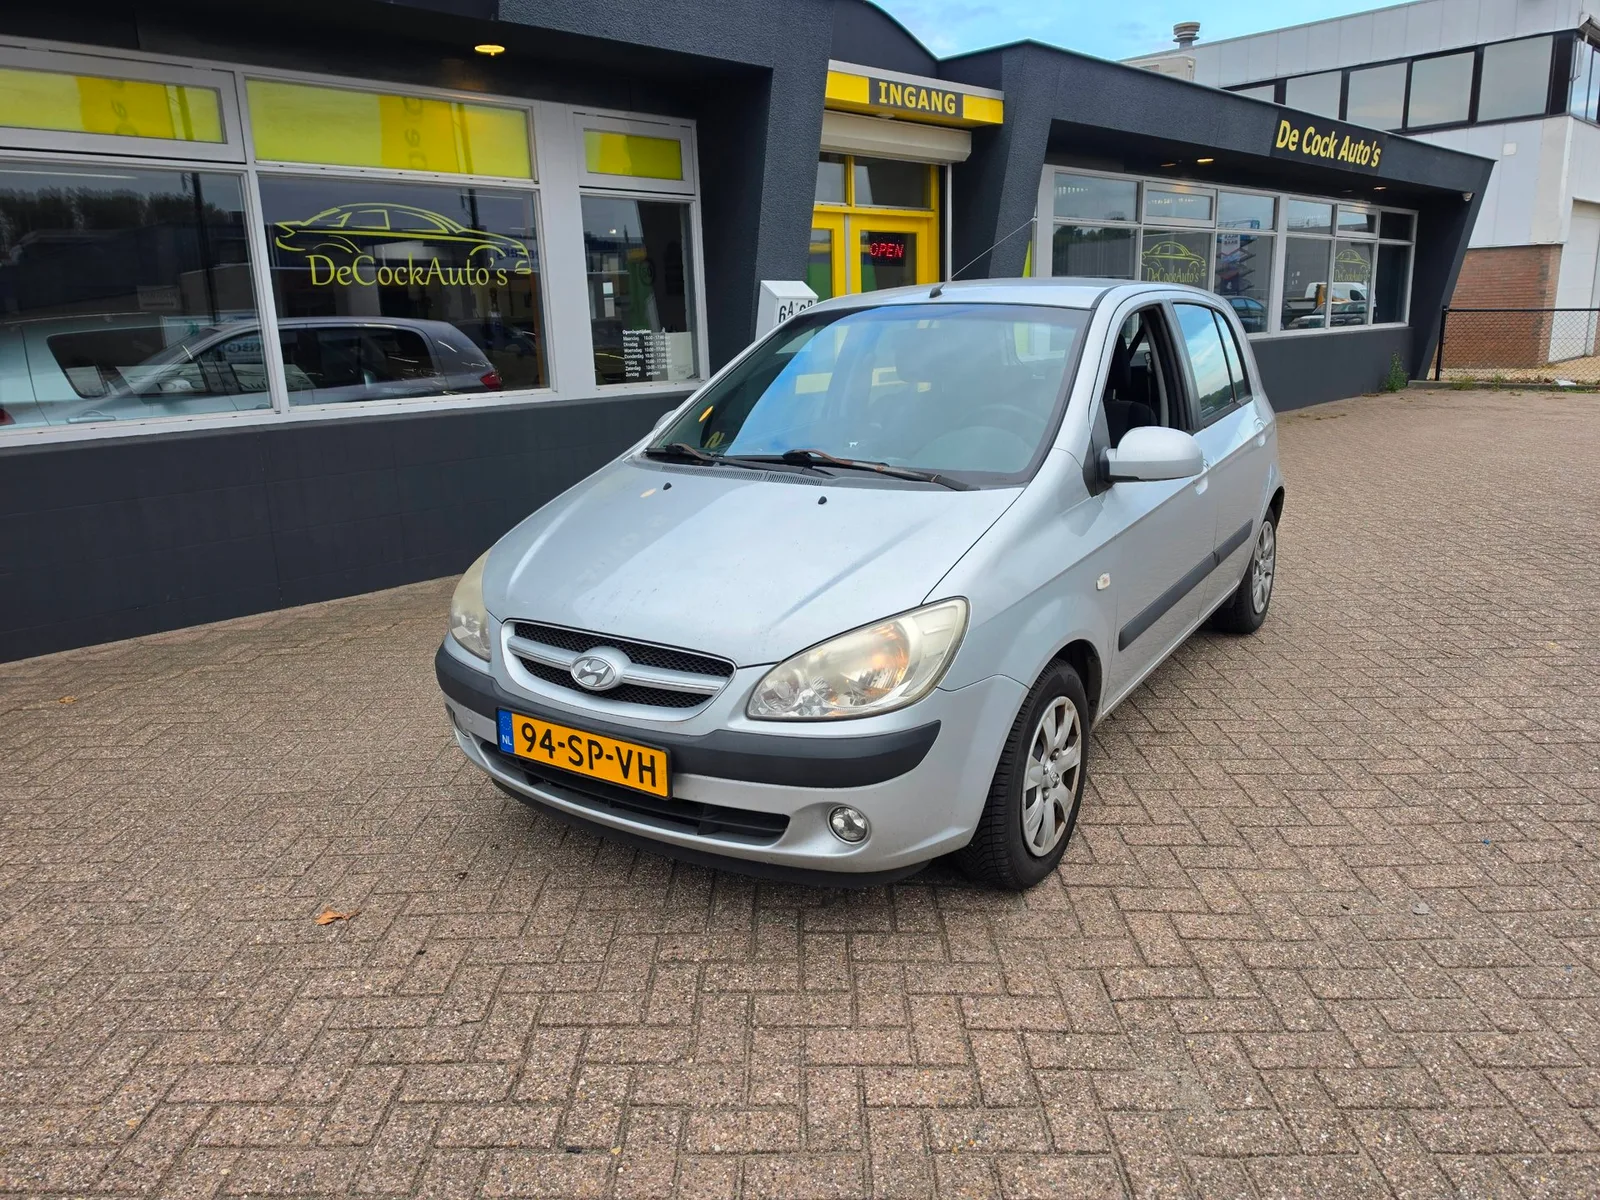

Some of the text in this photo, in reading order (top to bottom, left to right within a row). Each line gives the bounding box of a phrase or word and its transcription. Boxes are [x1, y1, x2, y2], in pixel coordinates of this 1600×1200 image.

[879, 81, 956, 115] INGANG
[1275, 119, 1382, 168] De Cock Auto's
[869, 242, 904, 258] OPEN
[305, 252, 508, 286] DeCockAuto's
[501, 734, 513, 746] NL
[521, 722, 657, 788] 94-SP-VH
